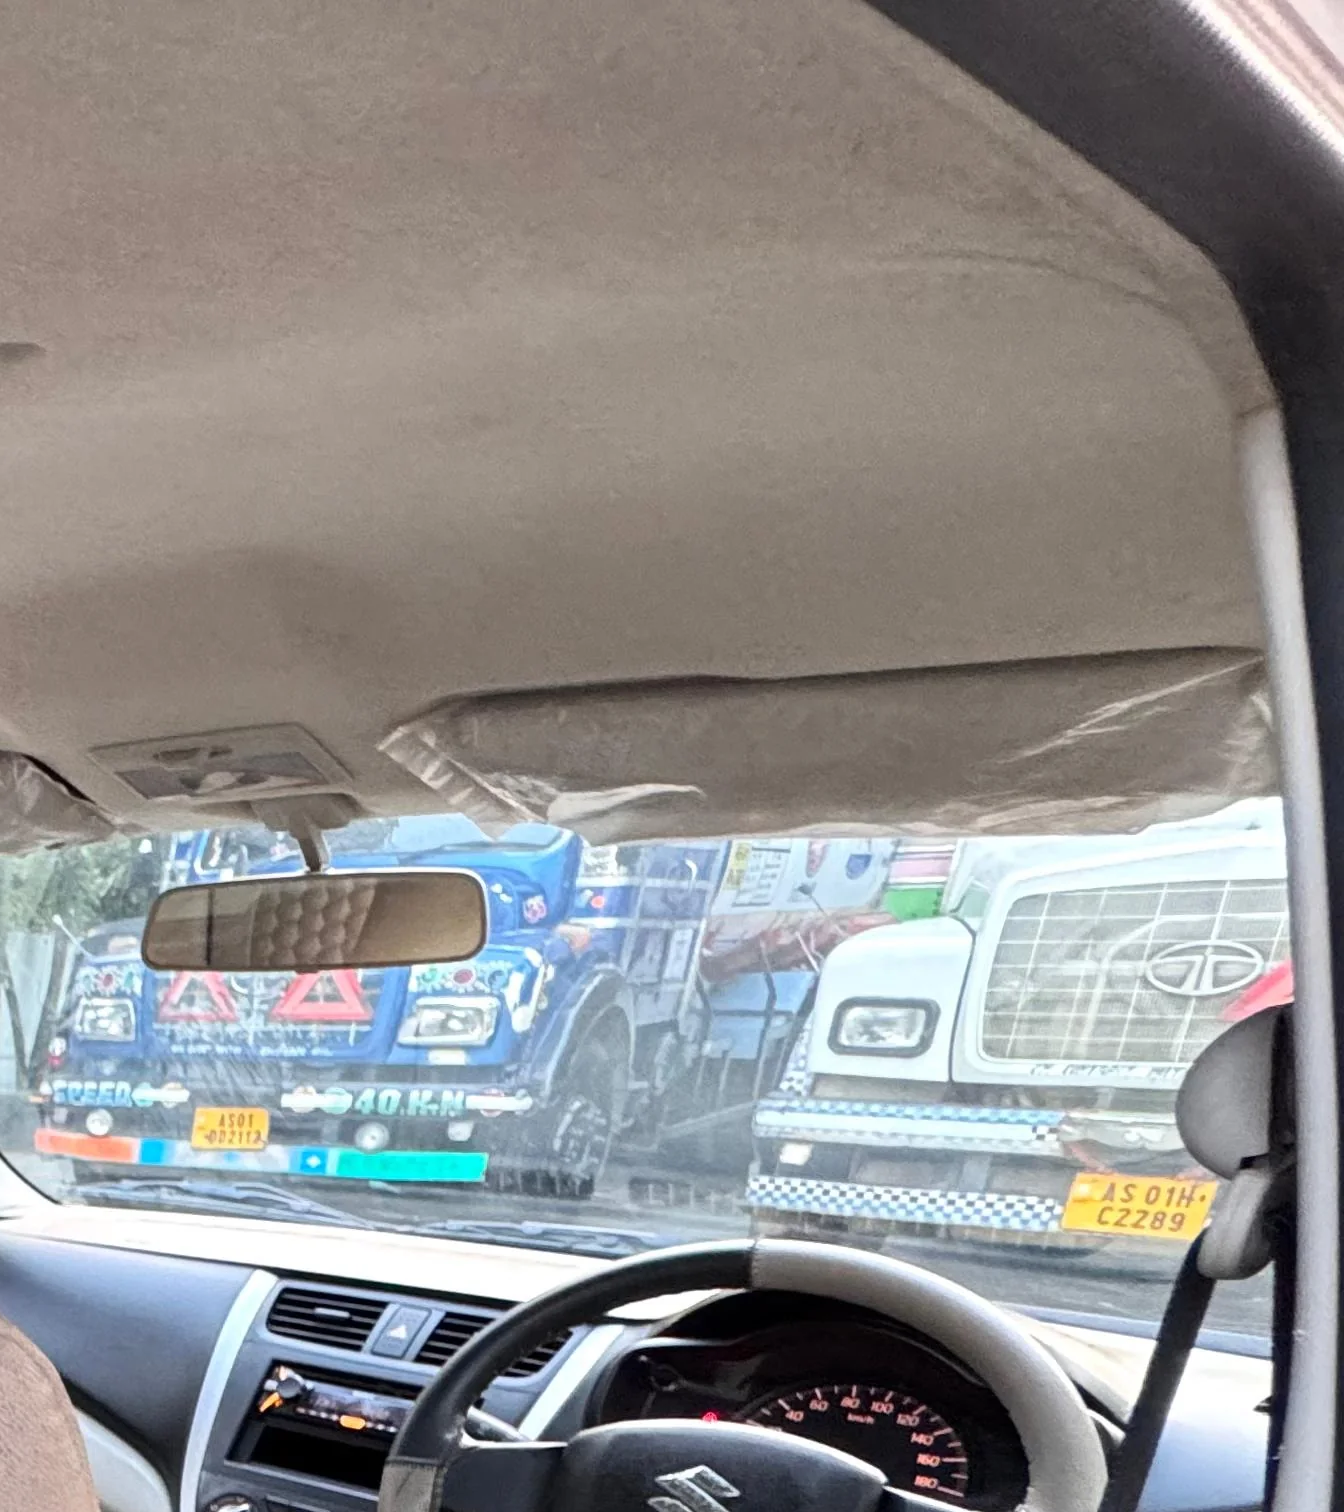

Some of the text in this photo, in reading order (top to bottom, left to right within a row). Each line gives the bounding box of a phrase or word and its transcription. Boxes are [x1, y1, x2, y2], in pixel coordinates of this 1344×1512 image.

[1097, 1206, 1186, 1232] C2289
[809, 1400, 829, 1411] 60
[871, 1401, 894, 1414] 100
[785, 1410, 804, 1422] 40
[896, 1413, 920, 1427] 120
[911, 1433, 934, 1447] 140
[916, 1453, 940, 1467] 160
[914, 1475, 938, 1489] 180
